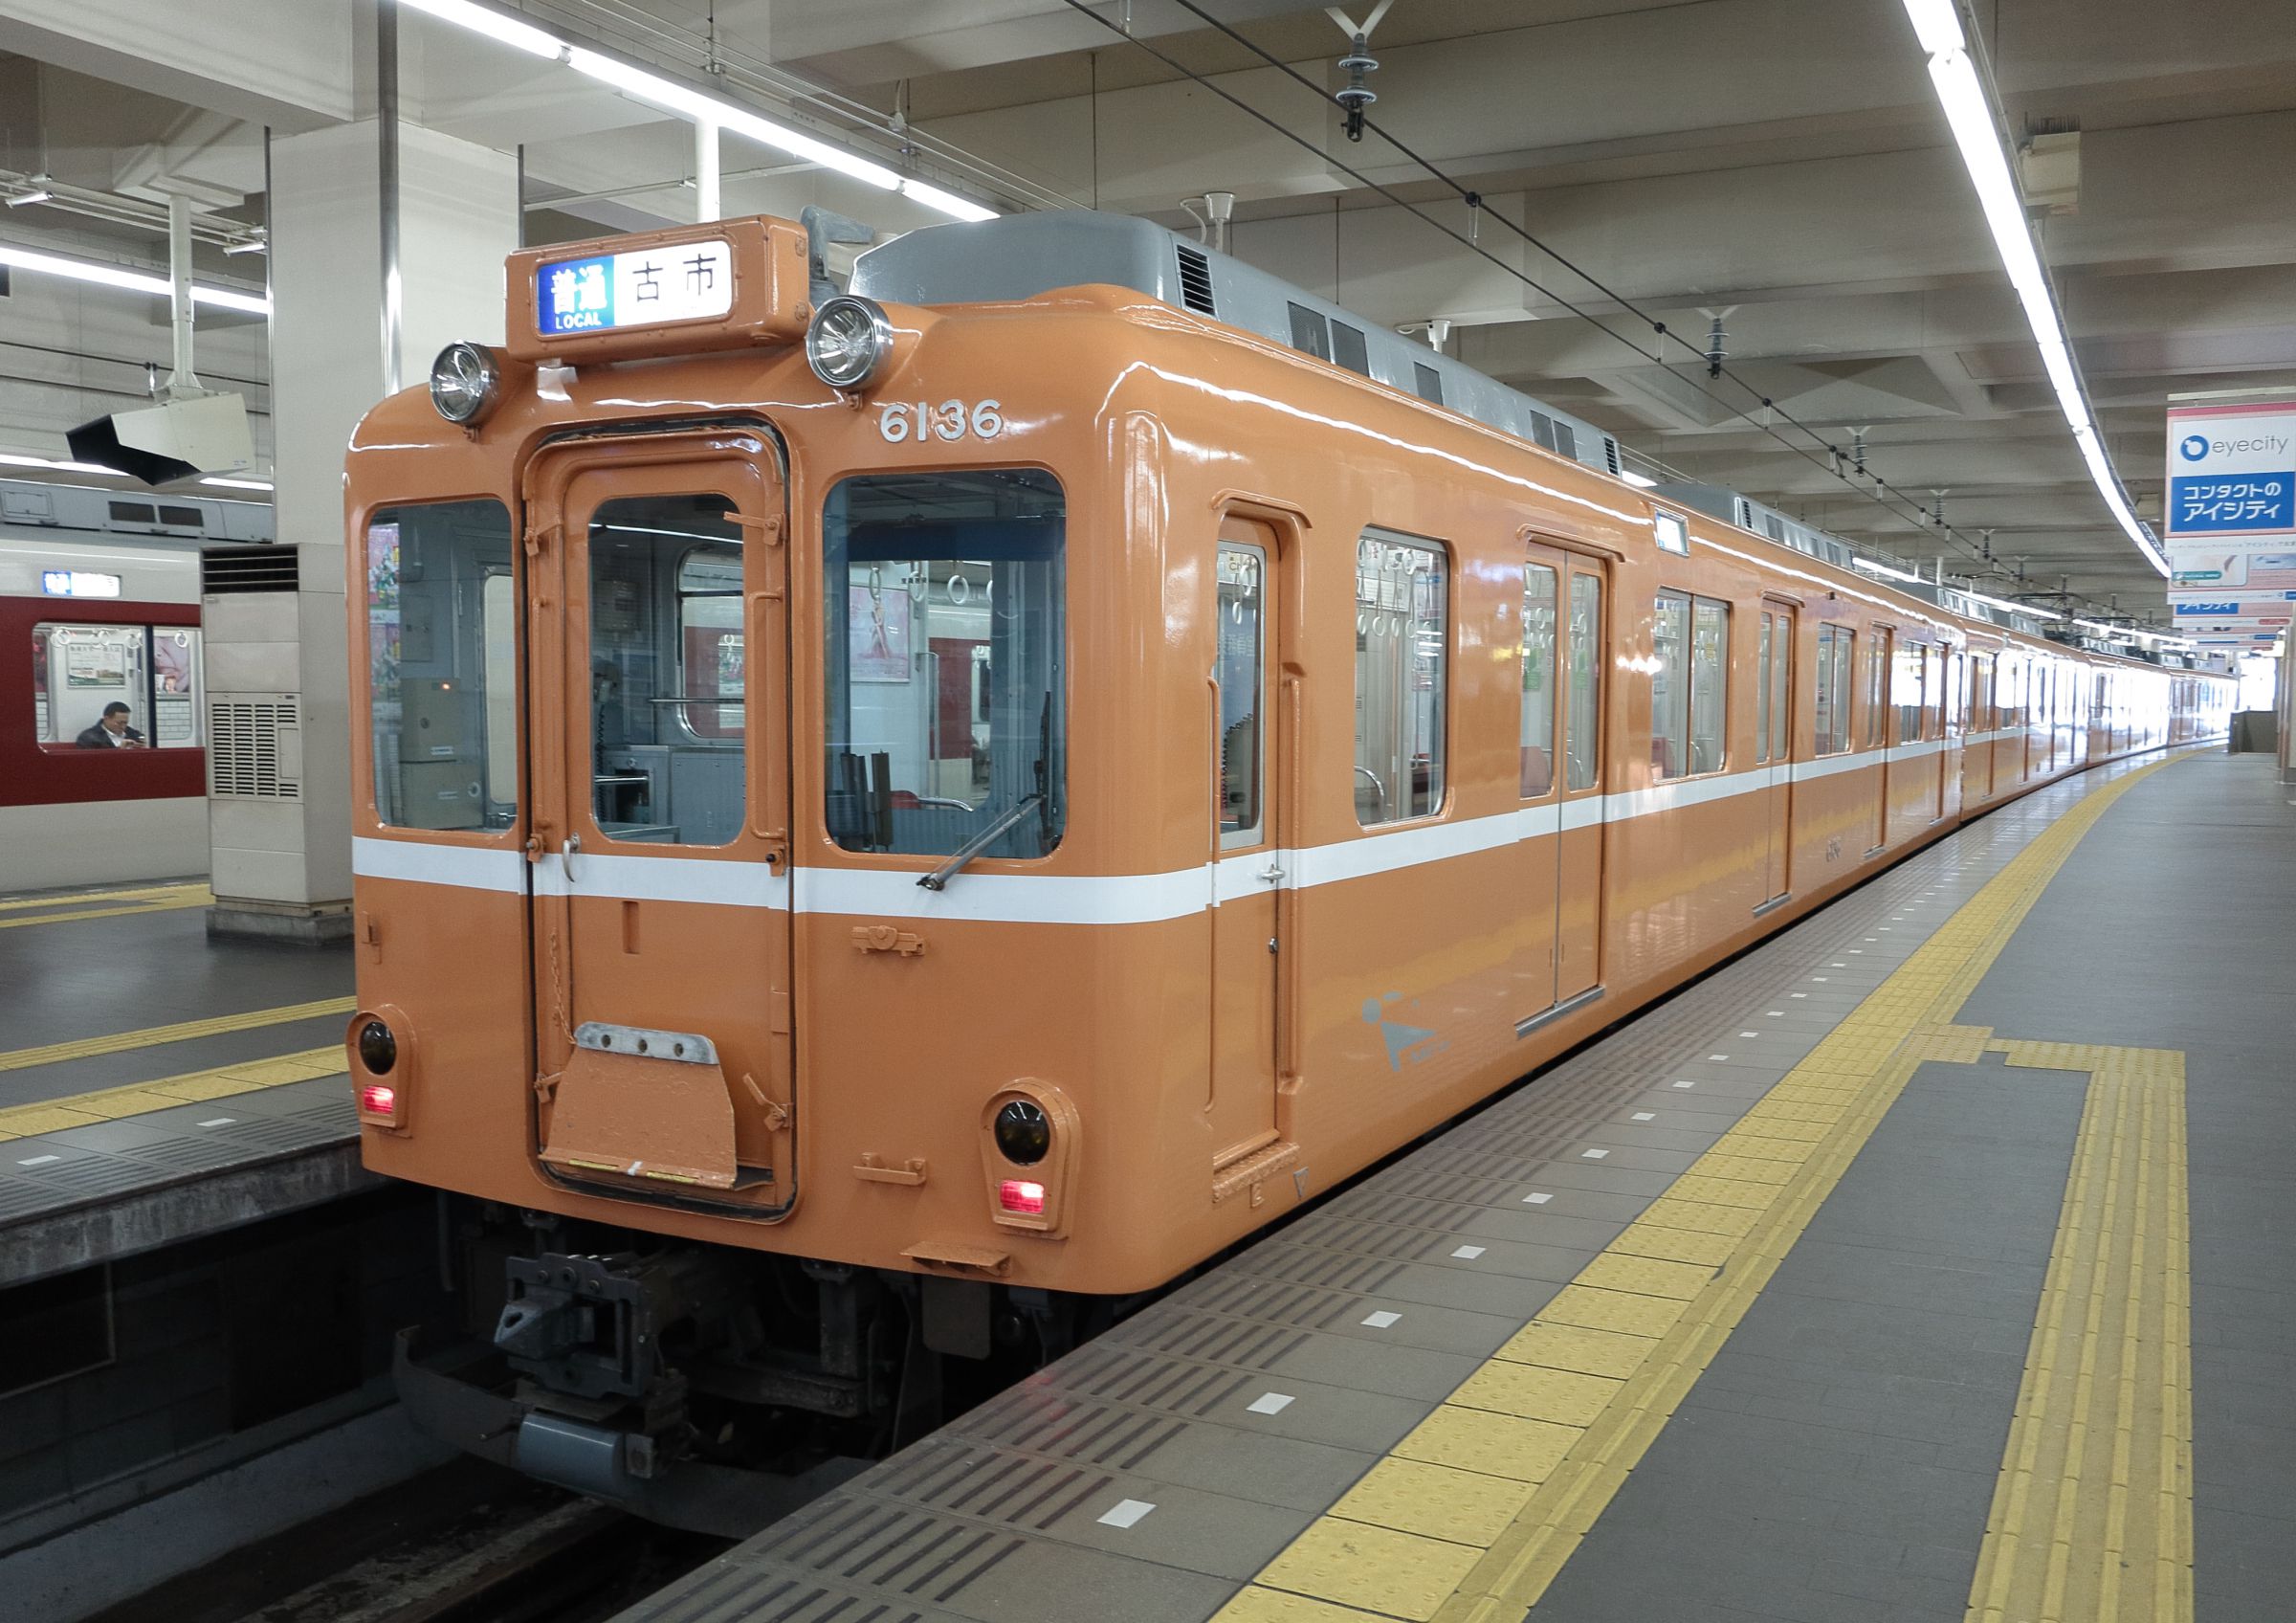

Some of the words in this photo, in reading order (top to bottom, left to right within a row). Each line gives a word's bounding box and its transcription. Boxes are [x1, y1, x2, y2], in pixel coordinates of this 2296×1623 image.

[551, 264, 608, 314] 普通
[632, 254, 718, 302] 古市
[555, 312, 603, 330] LOCAL
[880, 398, 1003, 443] 6136
[2211, 435, 2289, 457] eyecity
[2183, 481, 2283, 500] コンタクトの
[2183, 500, 2282, 522] アイシティ
